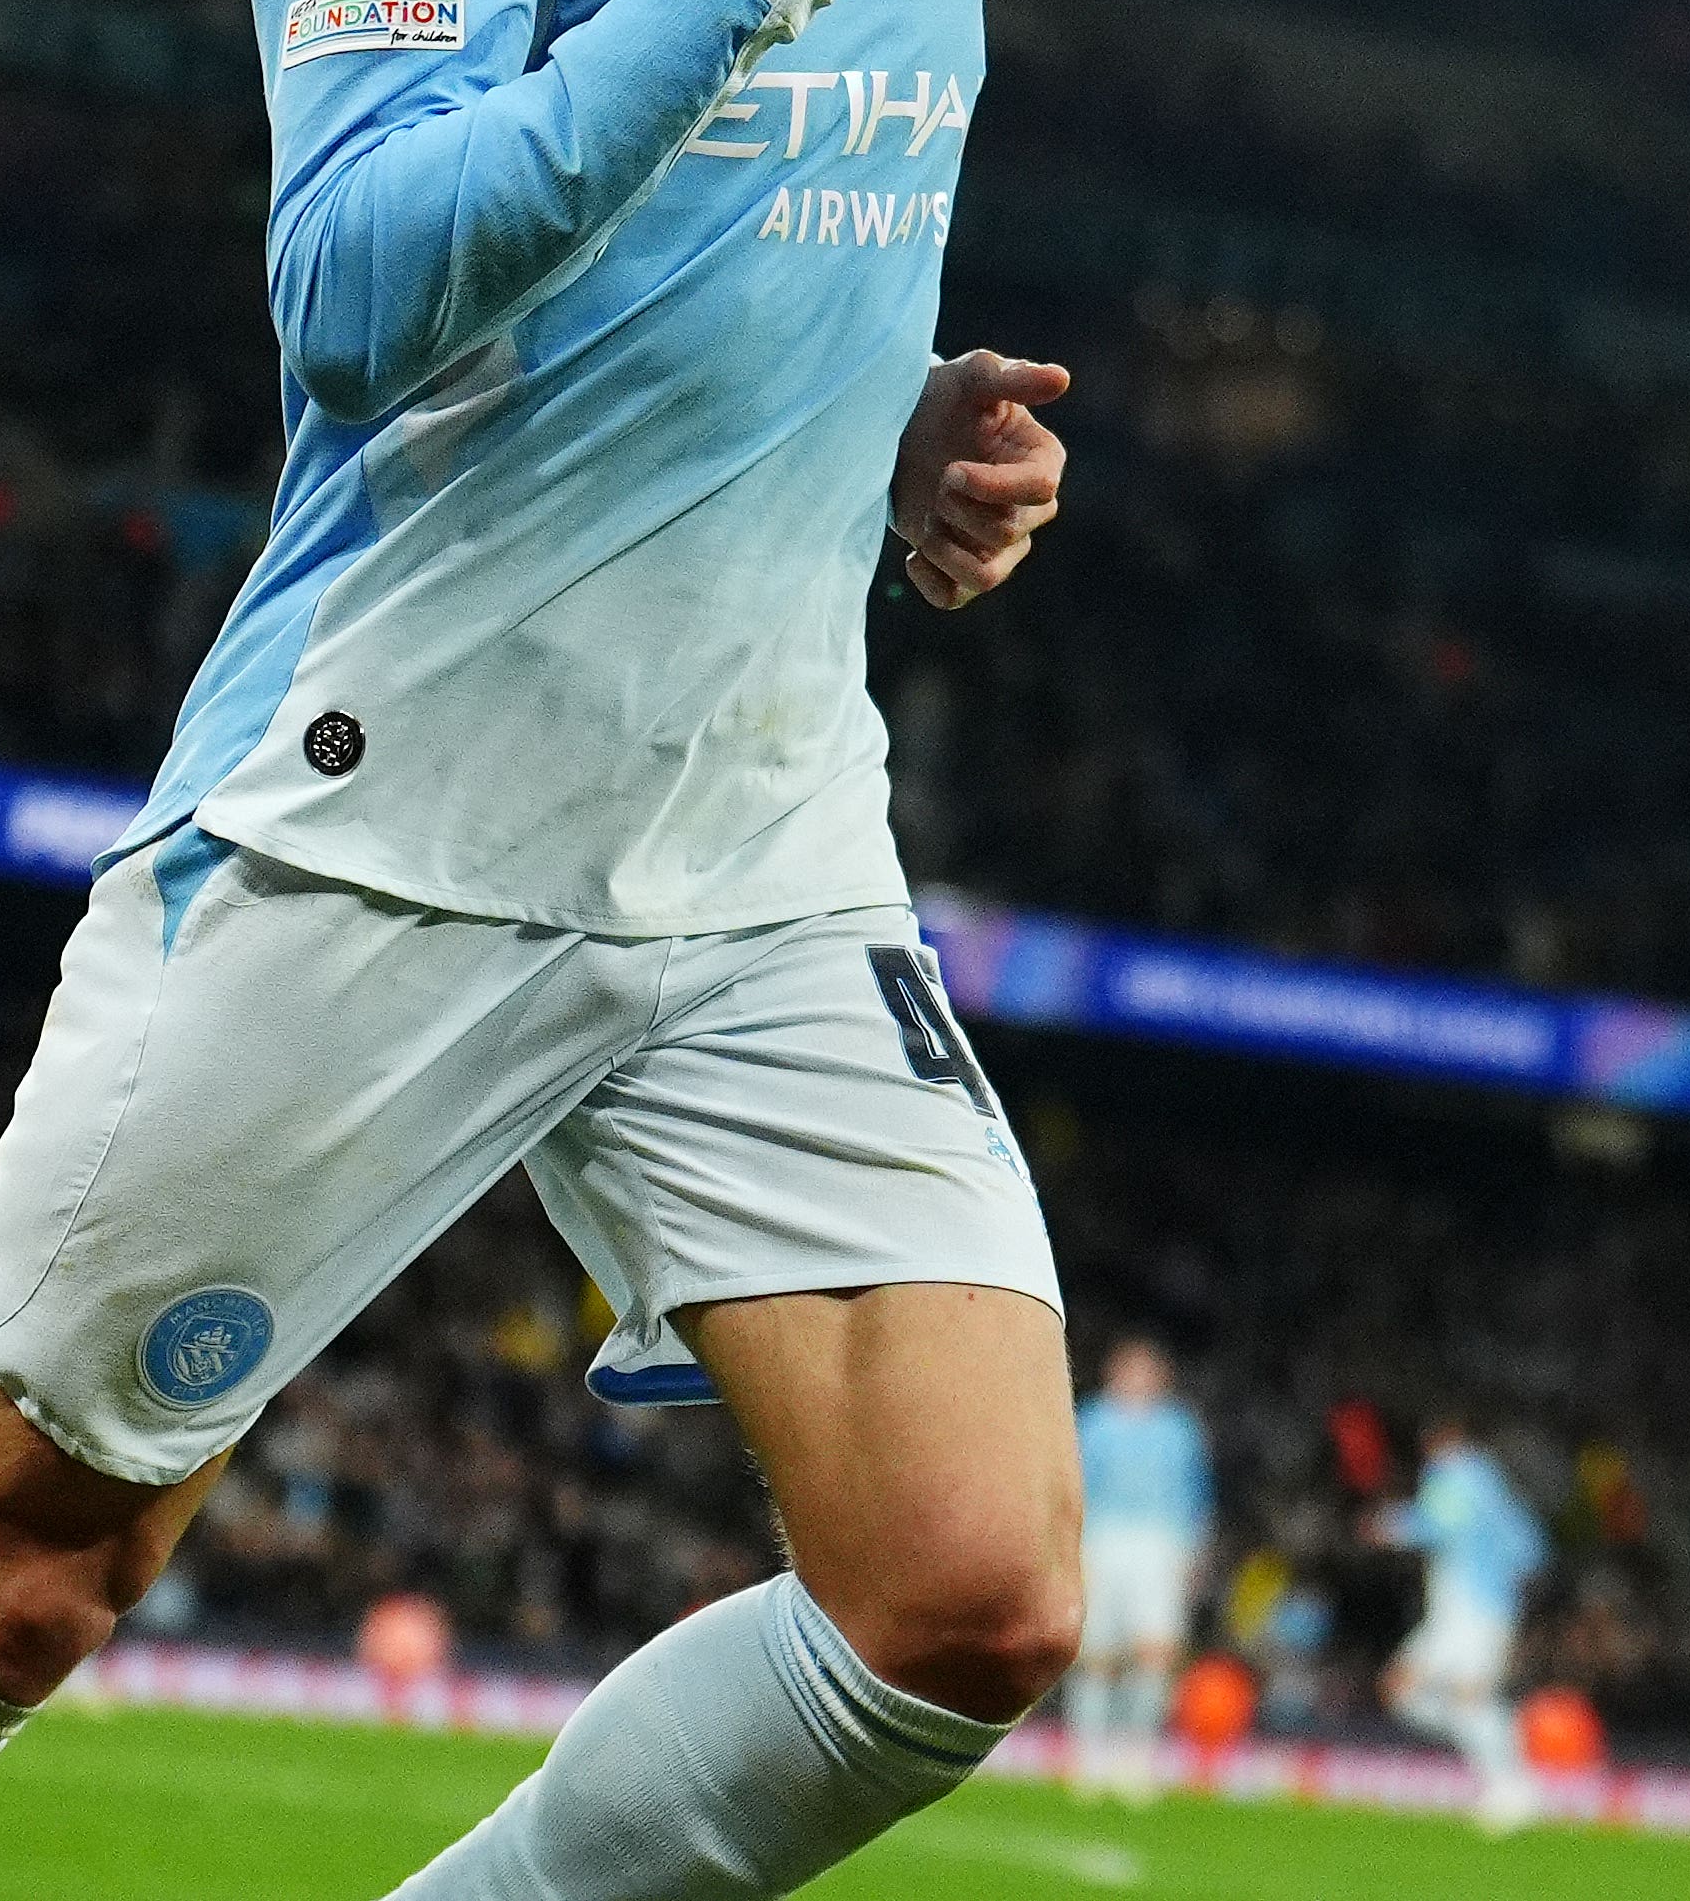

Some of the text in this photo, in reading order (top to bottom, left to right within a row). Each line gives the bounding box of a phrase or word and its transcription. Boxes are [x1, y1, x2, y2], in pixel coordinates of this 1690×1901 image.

[390, 28, 457, 45] for children
[685, 71, 984, 160] ETIHA
[756, 186, 948, 249] AIRWAYS
[864, 944, 999, 1120] 4
